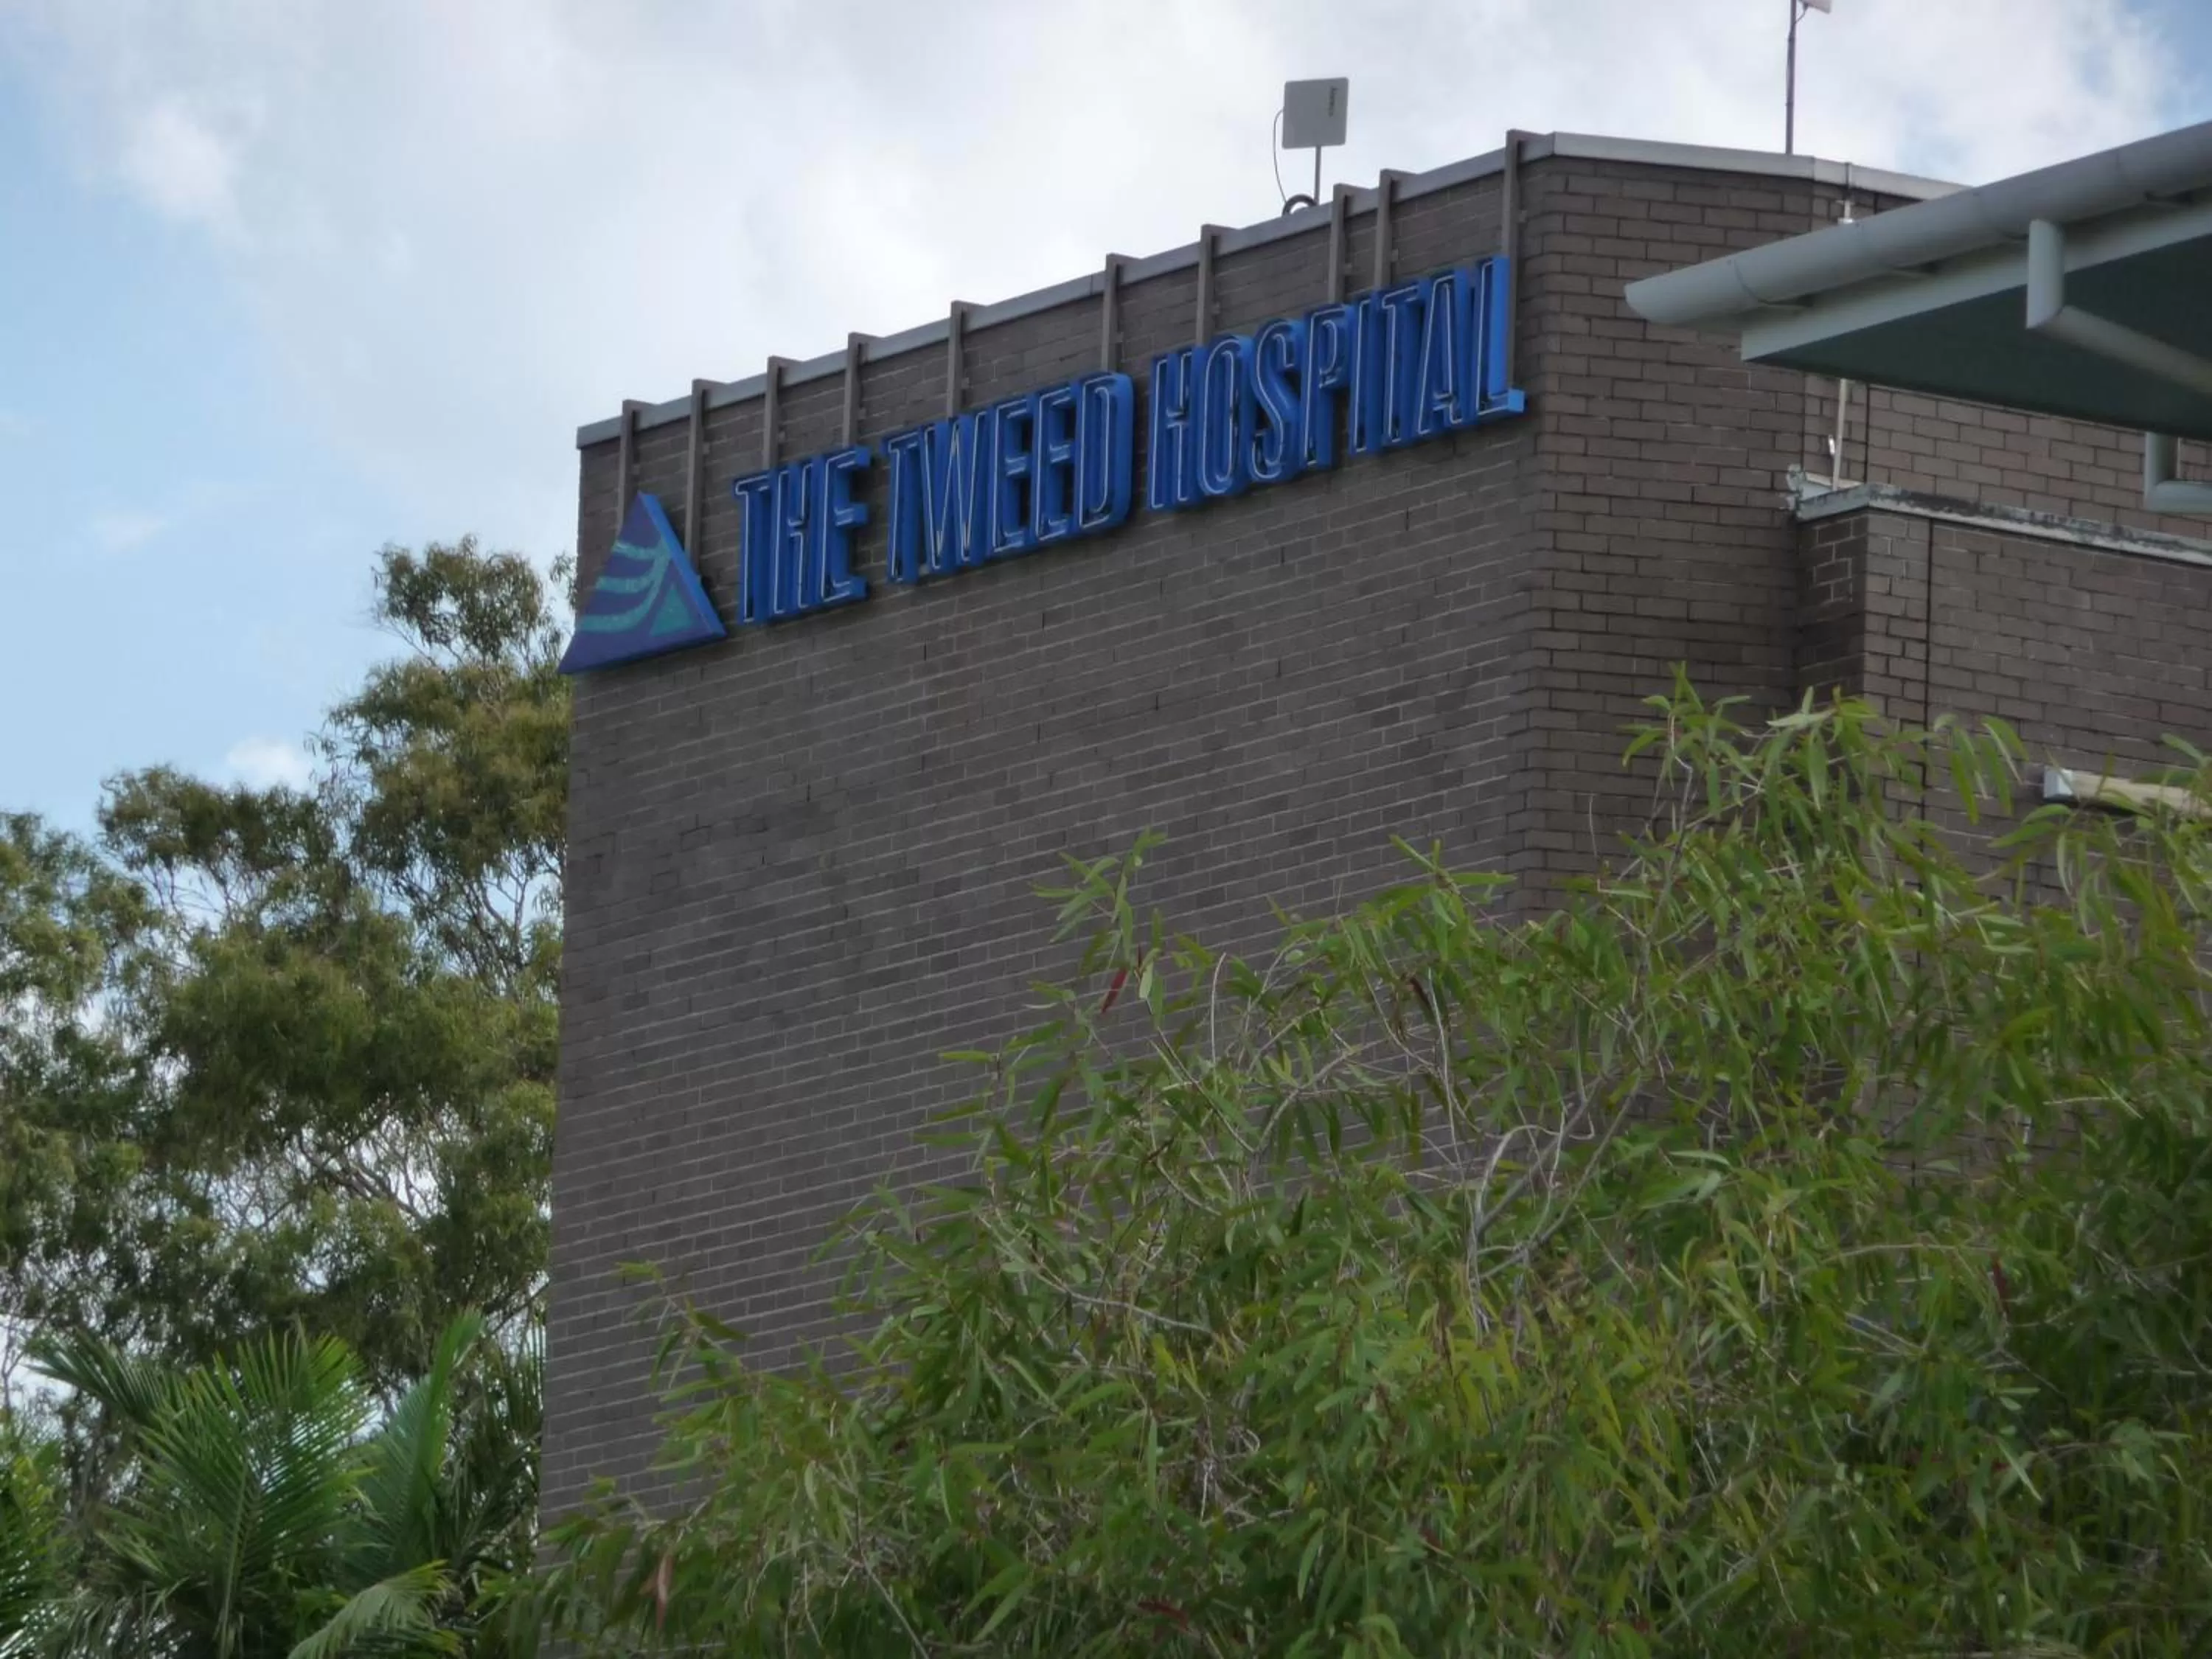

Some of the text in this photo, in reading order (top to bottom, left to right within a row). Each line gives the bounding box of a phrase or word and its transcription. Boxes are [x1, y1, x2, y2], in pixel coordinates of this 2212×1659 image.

[733, 255, 1525, 623] THE TWEED HOSPITAL
